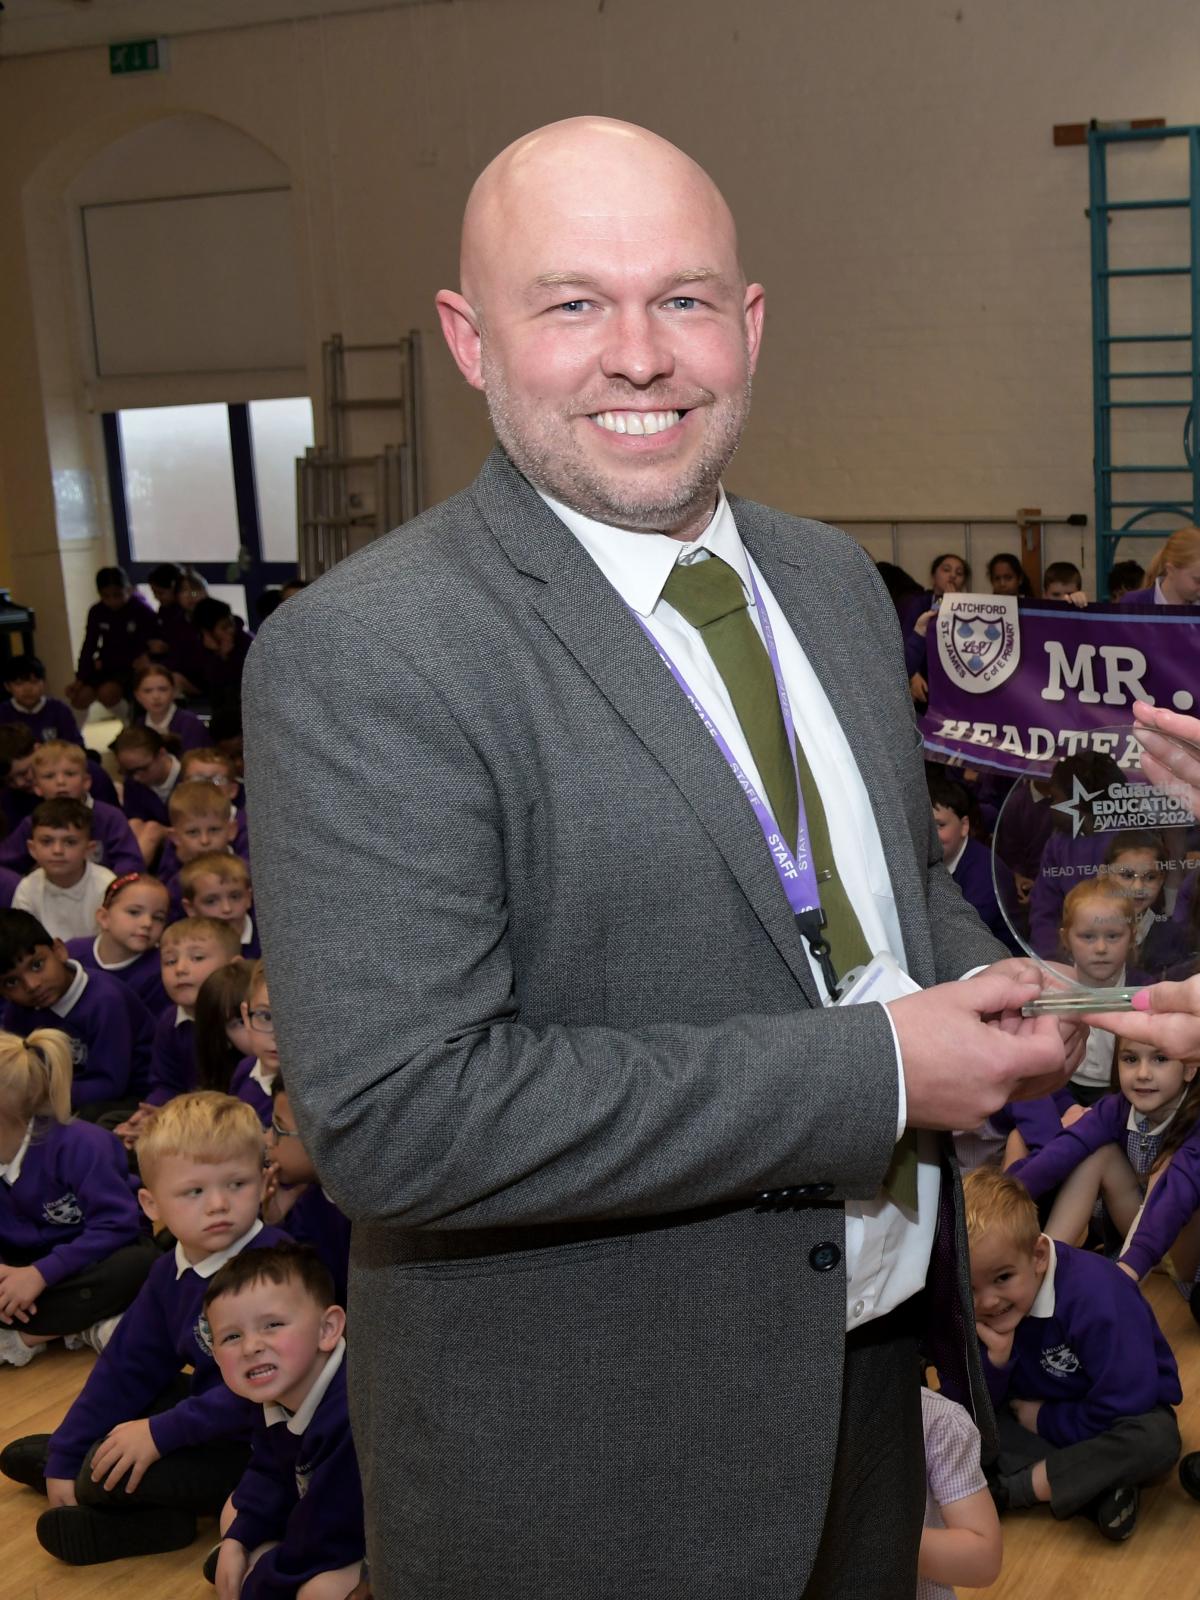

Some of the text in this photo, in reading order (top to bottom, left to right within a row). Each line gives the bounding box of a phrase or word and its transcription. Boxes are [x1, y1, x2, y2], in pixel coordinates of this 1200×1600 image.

[951, 602, 1007, 615] LATCHFORD
[941, 621, 967, 679] ST. JAMES
[983, 673, 991, 682] C
[998, 660, 1006, 669] E
[1002, 621, 1015, 662] PRIMARY
[1092, 797, 1192, 815] EDUCATION
[1094, 810, 1195, 829] AWARDS 2024
[768, 833, 798, 880] STAFF
[1042, 866, 1074, 878] HEAD
[1154, 859, 1176, 871] THE
